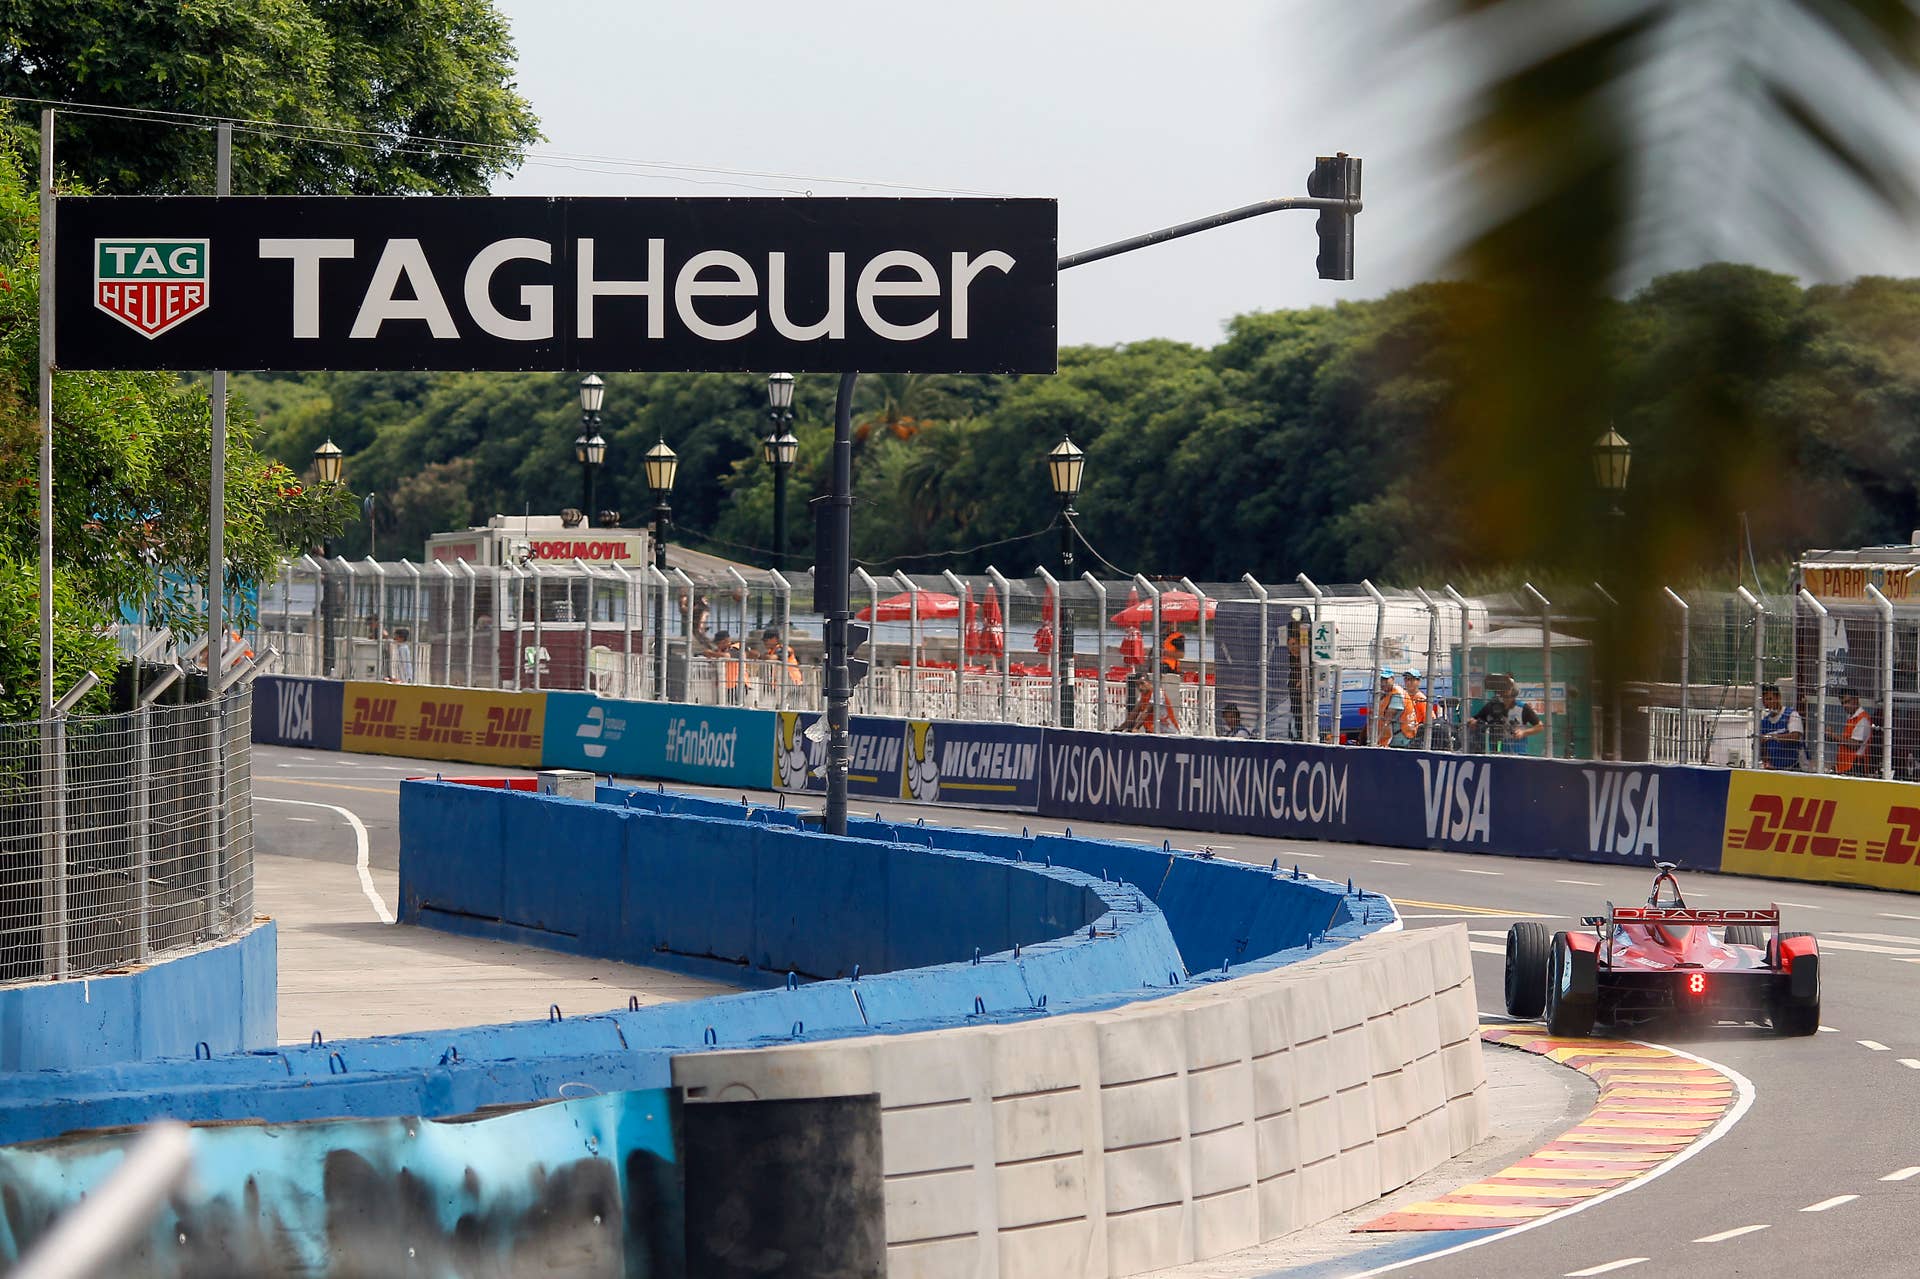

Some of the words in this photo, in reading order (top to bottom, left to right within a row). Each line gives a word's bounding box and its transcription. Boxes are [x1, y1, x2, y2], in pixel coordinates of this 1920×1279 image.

[105, 246, 198, 275] TAG
[102, 285, 201, 330] HEUER
[529, 541, 631, 560] HORIMOVIL
[276, 680, 312, 741] VISA
[353, 697, 400, 739] DHL
[417, 701, 465, 744] DHL
[484, 706, 532, 749] DHL
[666, 718, 737, 768] #FanBoost
[809, 735, 901, 772] MHELIN
[941, 742, 1037, 780] MICHELIN
[1049, 743, 1168, 809] VISIONARY
[1175, 752, 1348, 824] THINKING.COM
[1417, 759, 1491, 843] VISA
[1582, 769, 1660, 856] VISA
[1744, 794, 1841, 857] DHL
[1615, 909, 1777, 920] DRAGON
